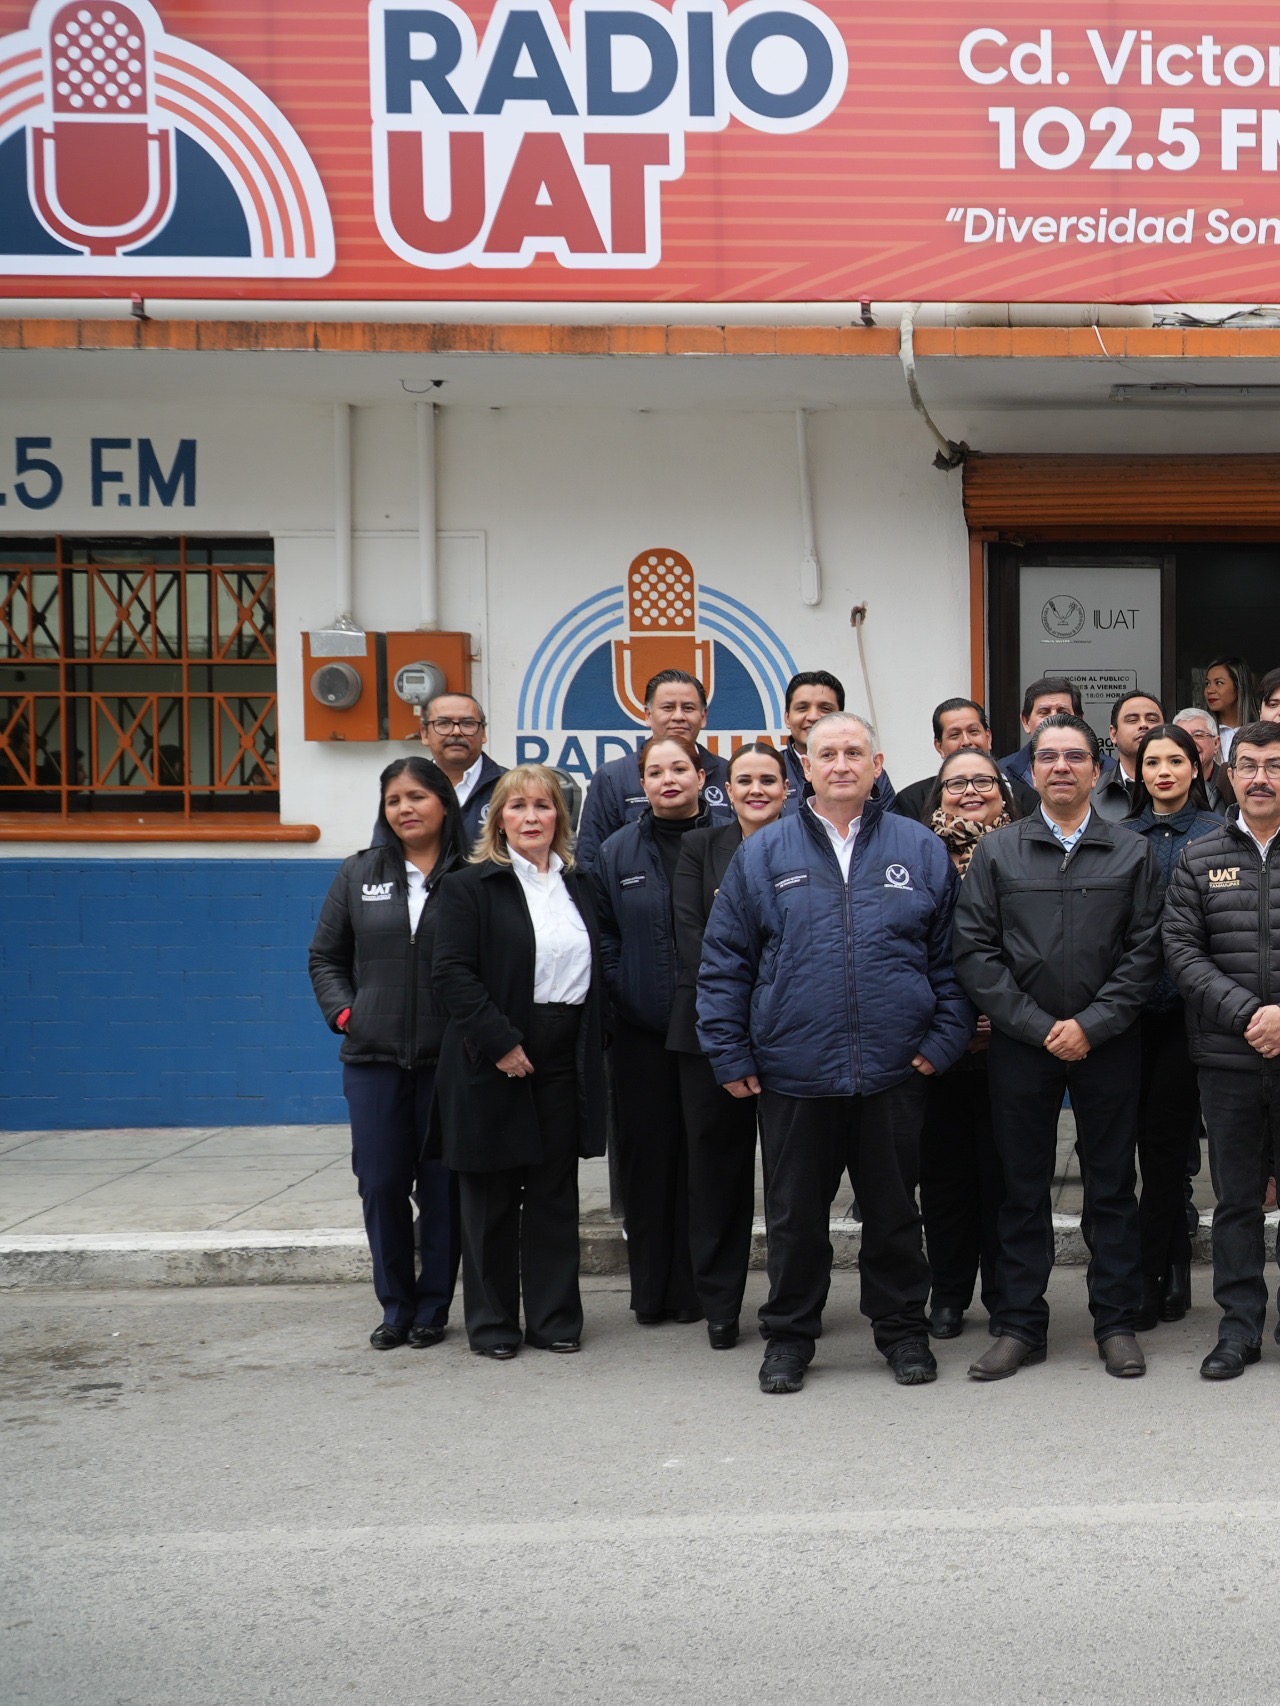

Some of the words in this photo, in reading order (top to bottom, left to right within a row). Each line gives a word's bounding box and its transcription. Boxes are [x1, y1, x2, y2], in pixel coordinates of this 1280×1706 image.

[383, 9, 834, 118] RADIO
[959, 28, 1069, 86] Cd.
[988, 106, 1200, 171] 102.5
[387, 131, 670, 254] UAT
[362, 882, 393, 896] UAT
[1209, 867, 1240, 881] UAT
